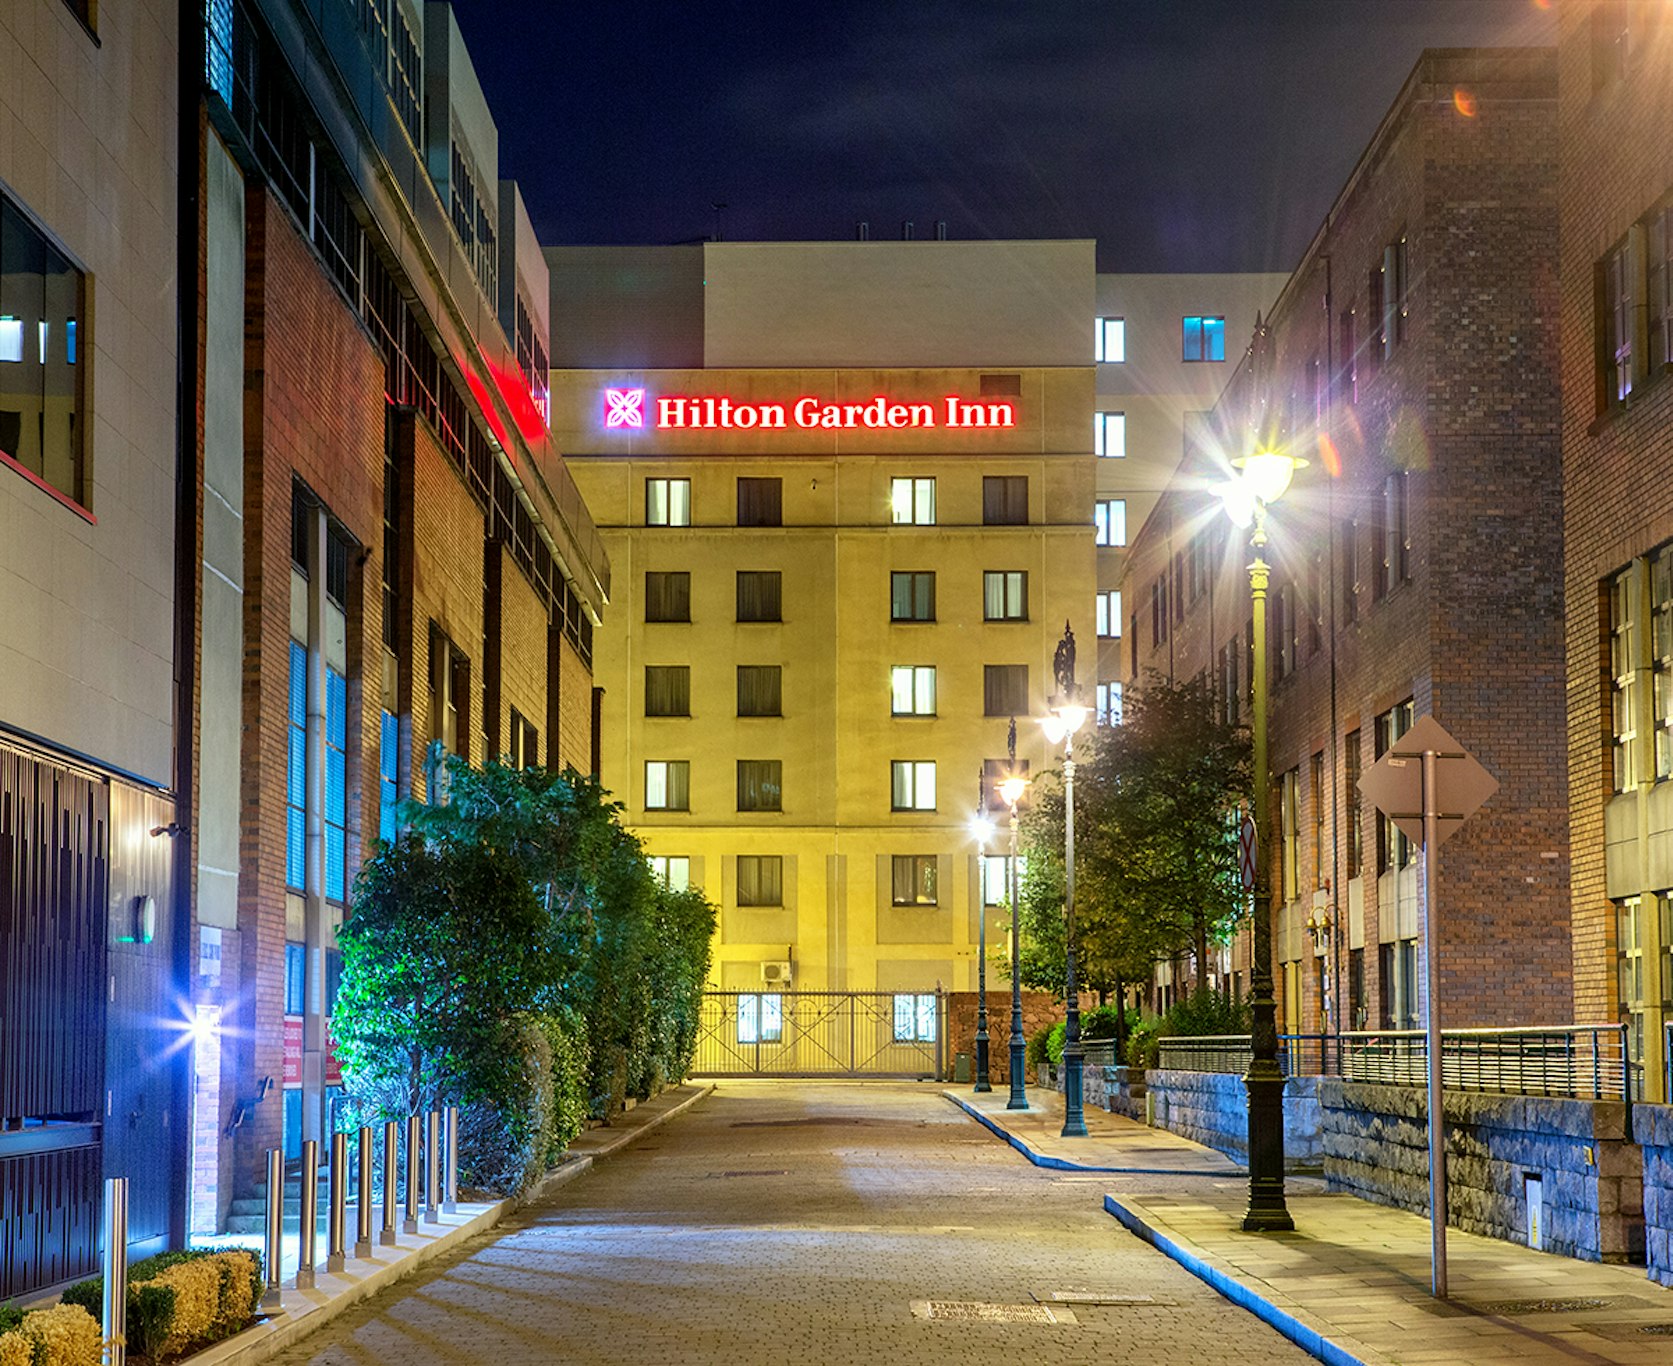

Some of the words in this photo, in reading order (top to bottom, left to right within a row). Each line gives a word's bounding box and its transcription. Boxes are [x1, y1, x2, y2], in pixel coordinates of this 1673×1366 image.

[657, 398, 788, 429] Hilton
[794, 397, 936, 428] Garden
[945, 396, 1015, 428] Inn
